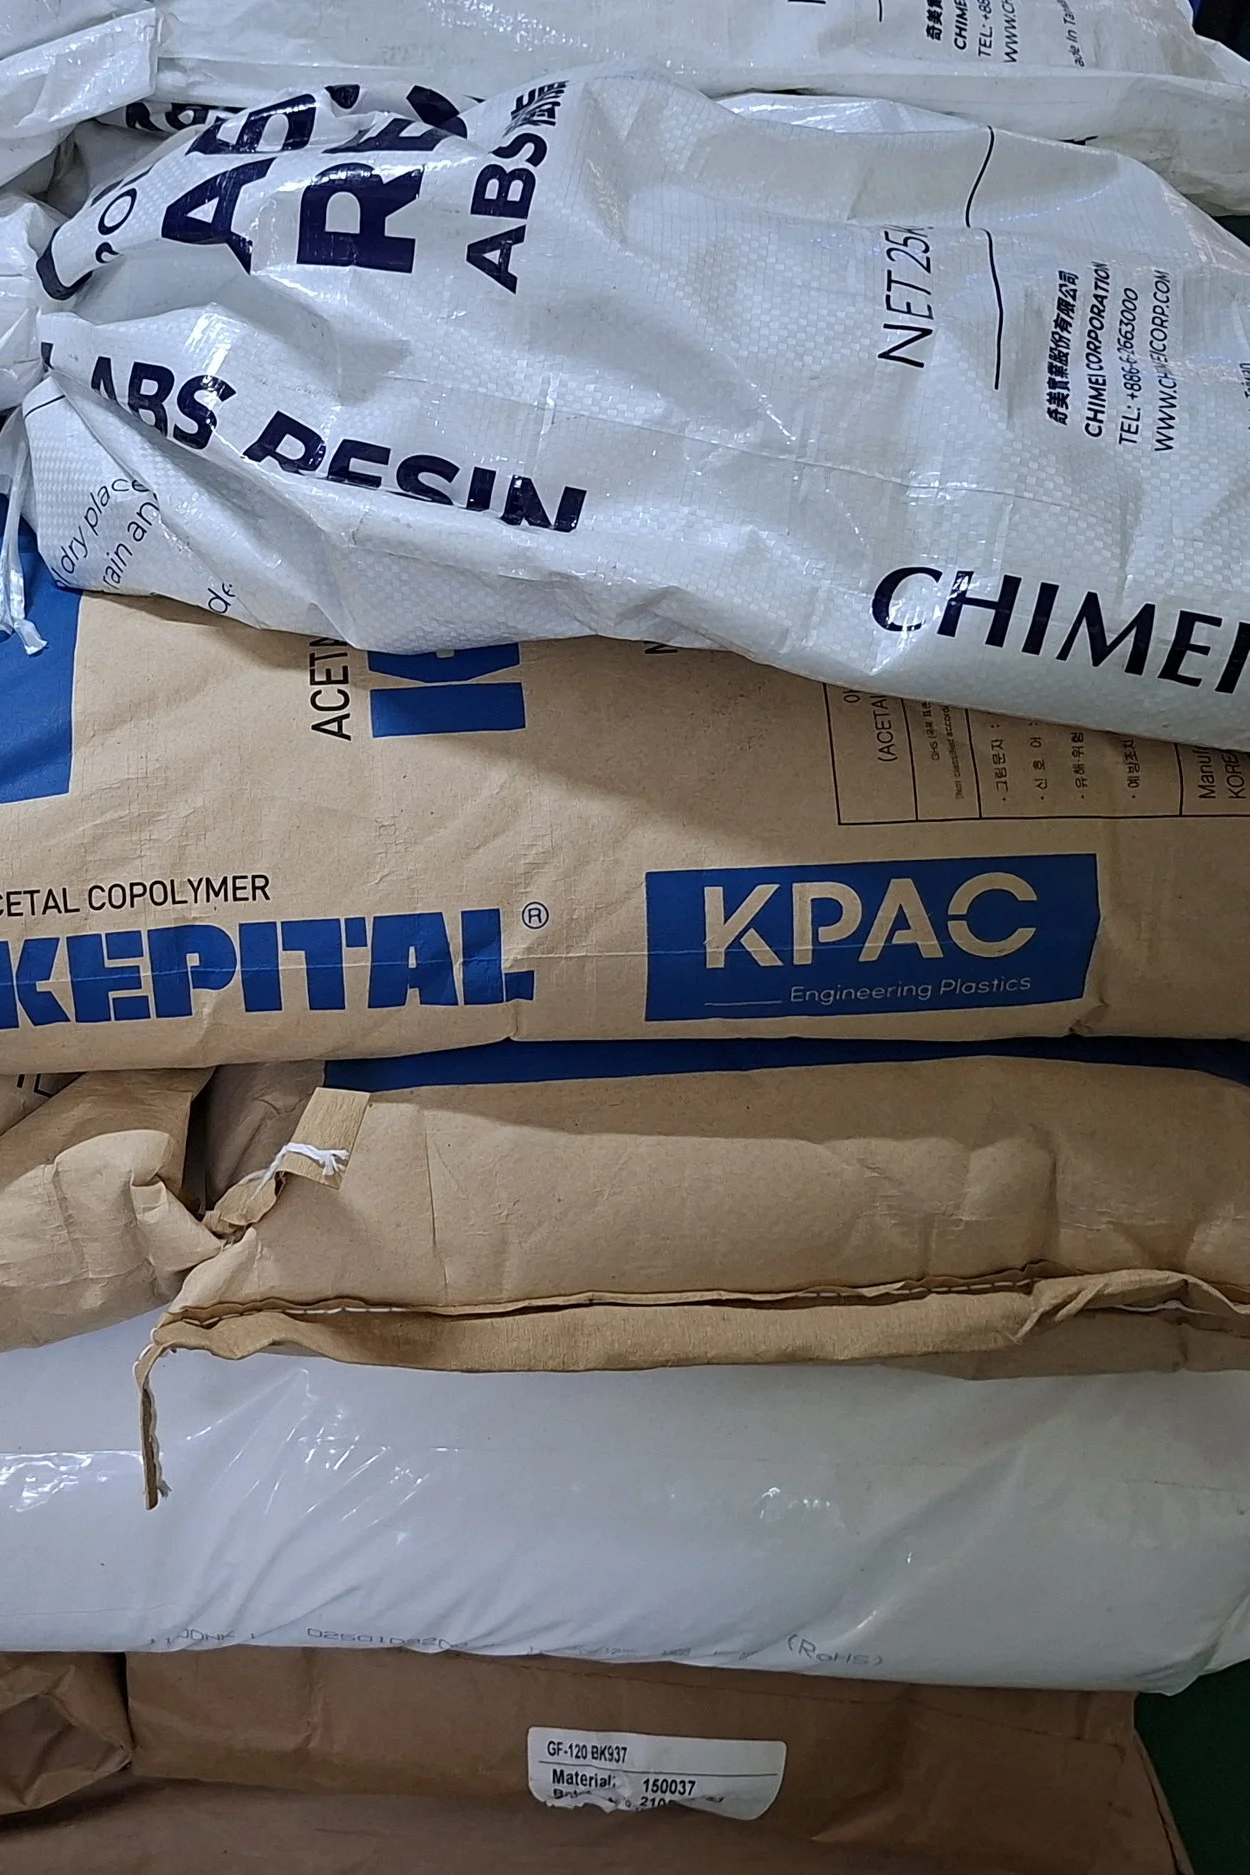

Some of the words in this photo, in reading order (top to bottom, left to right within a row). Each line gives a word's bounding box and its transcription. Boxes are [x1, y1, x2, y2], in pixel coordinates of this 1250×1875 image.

[877, 269, 935, 369] NET
[1086, 261, 1111, 372] CORPORATION
[90, 355, 237, 450] ABS
[1084, 374, 1107, 438] CHIMEI
[1118, 407, 1142, 445] TEL:
[60, 525, 89, 576] dry
[101, 541, 133, 591] rain
[871, 566, 1250, 696] CHIMEI
[991, 738, 1009, 792] 그림문자
[86, 874, 271, 911] COPOLYMER
[703, 870, 1038, 969] KPAC
[790, 982, 933, 1006] Engineering
[938, 975, 1032, 998] Plastics
[547, 1740, 588, 1761] GF-120
[590, 1744, 628, 1764] BK937
[642, 1778, 696, 1797] 150037
